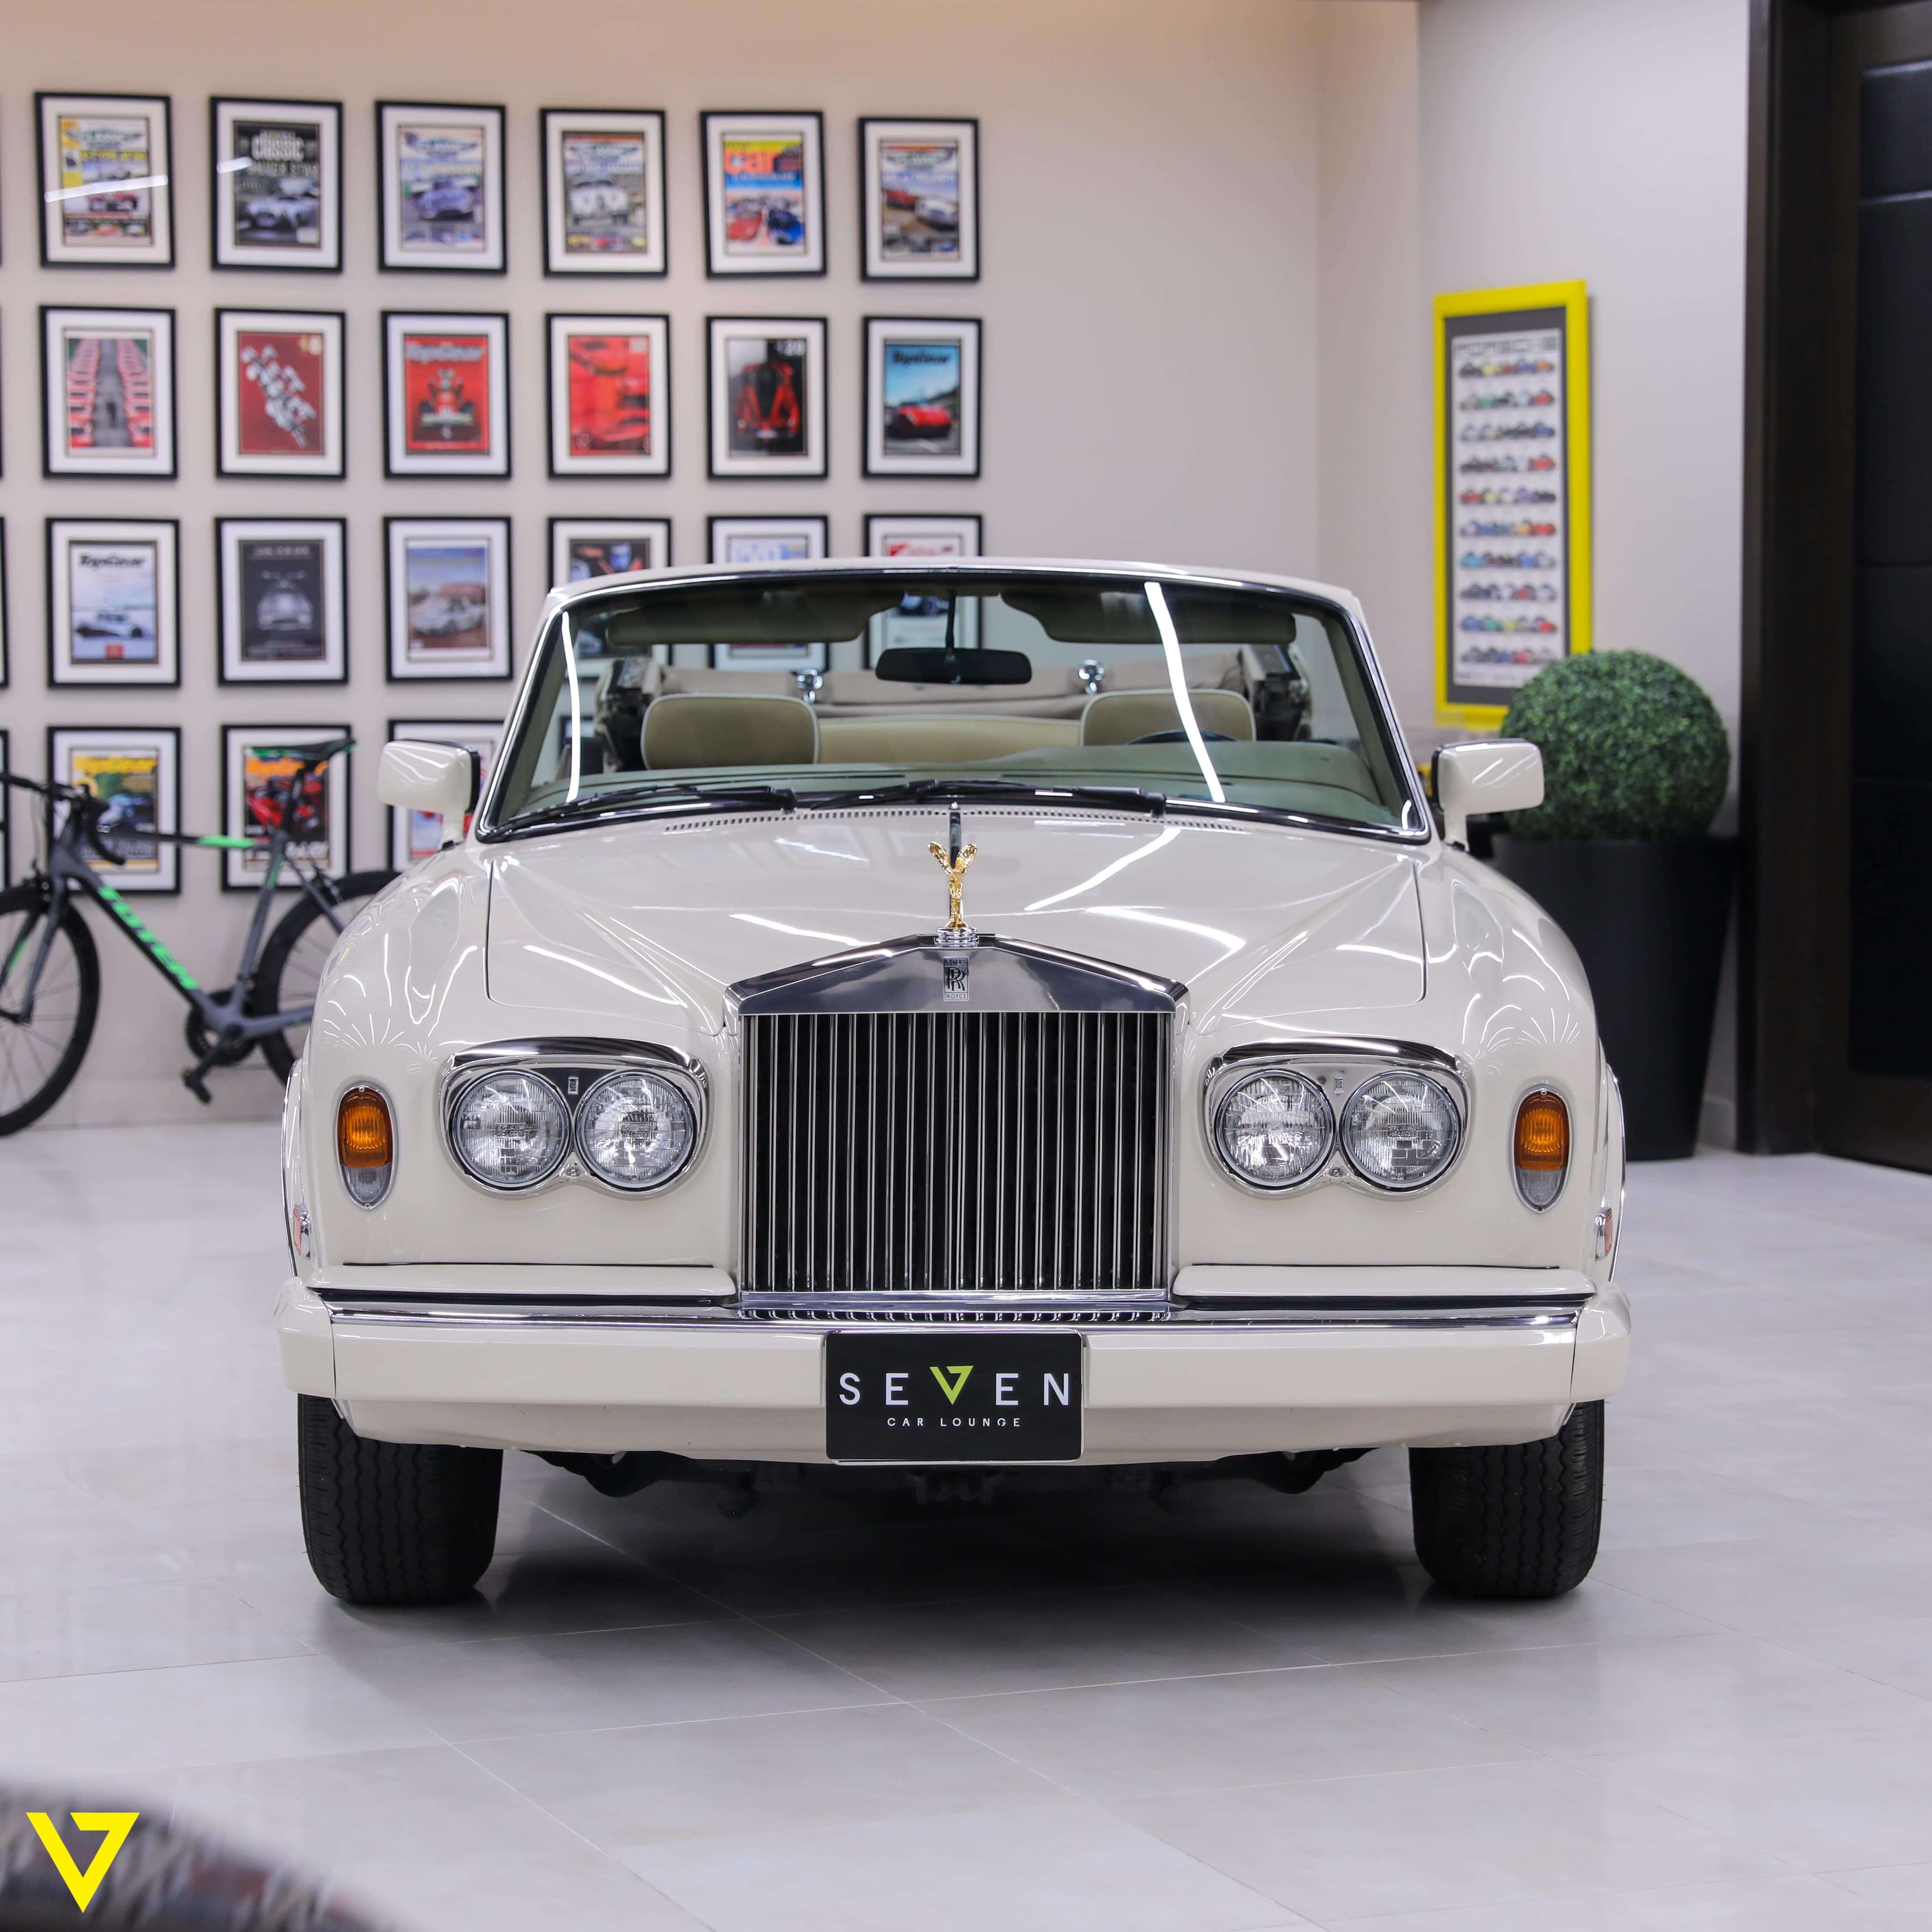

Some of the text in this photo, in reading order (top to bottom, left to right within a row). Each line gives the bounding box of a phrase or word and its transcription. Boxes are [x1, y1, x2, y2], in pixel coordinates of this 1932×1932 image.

[839, 1365, 1069, 1406] SEVEN
[887, 1417, 1020, 1427] CAR LOUNGE
